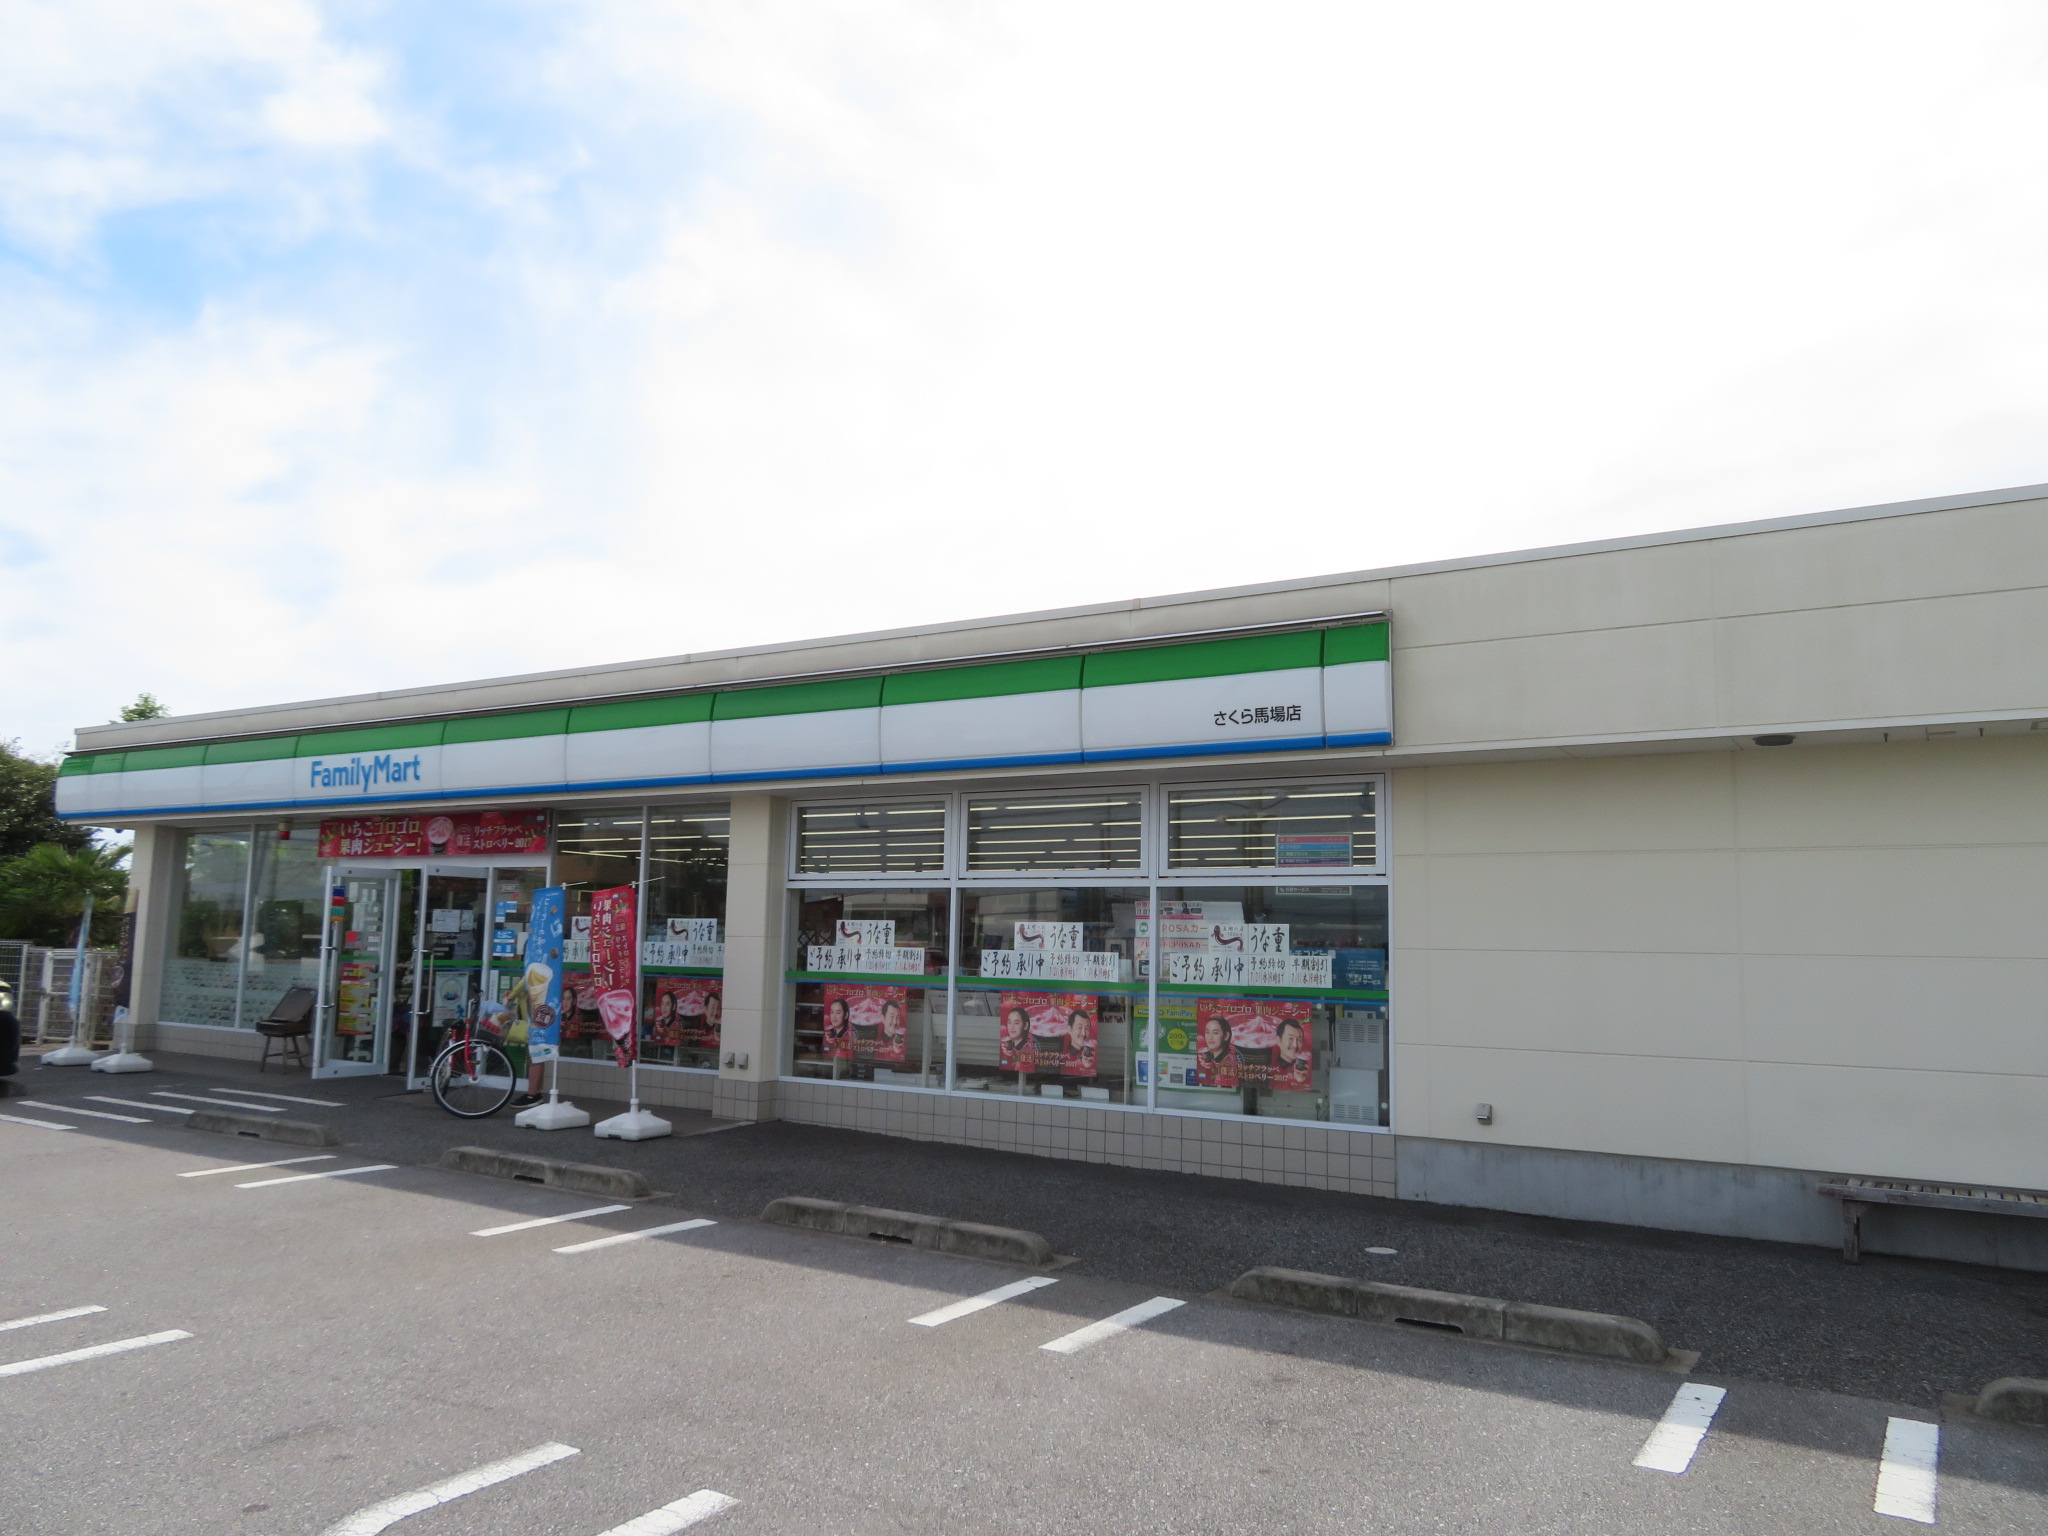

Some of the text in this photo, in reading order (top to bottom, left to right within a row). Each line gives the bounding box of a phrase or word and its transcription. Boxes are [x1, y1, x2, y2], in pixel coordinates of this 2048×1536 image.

[1214, 705, 1302, 726] さくら馬場店
[311, 755, 420, 792] FamilyMart
[339, 817, 424, 837] いちごゴロゴロ、
[693, 921, 714, 941] うな重
[867, 922, 892, 945] うな重
[1050, 924, 1079, 949] うな重
[1251, 926, 1285, 952] うな重
[1292, 958, 1328, 971] 早期割引
